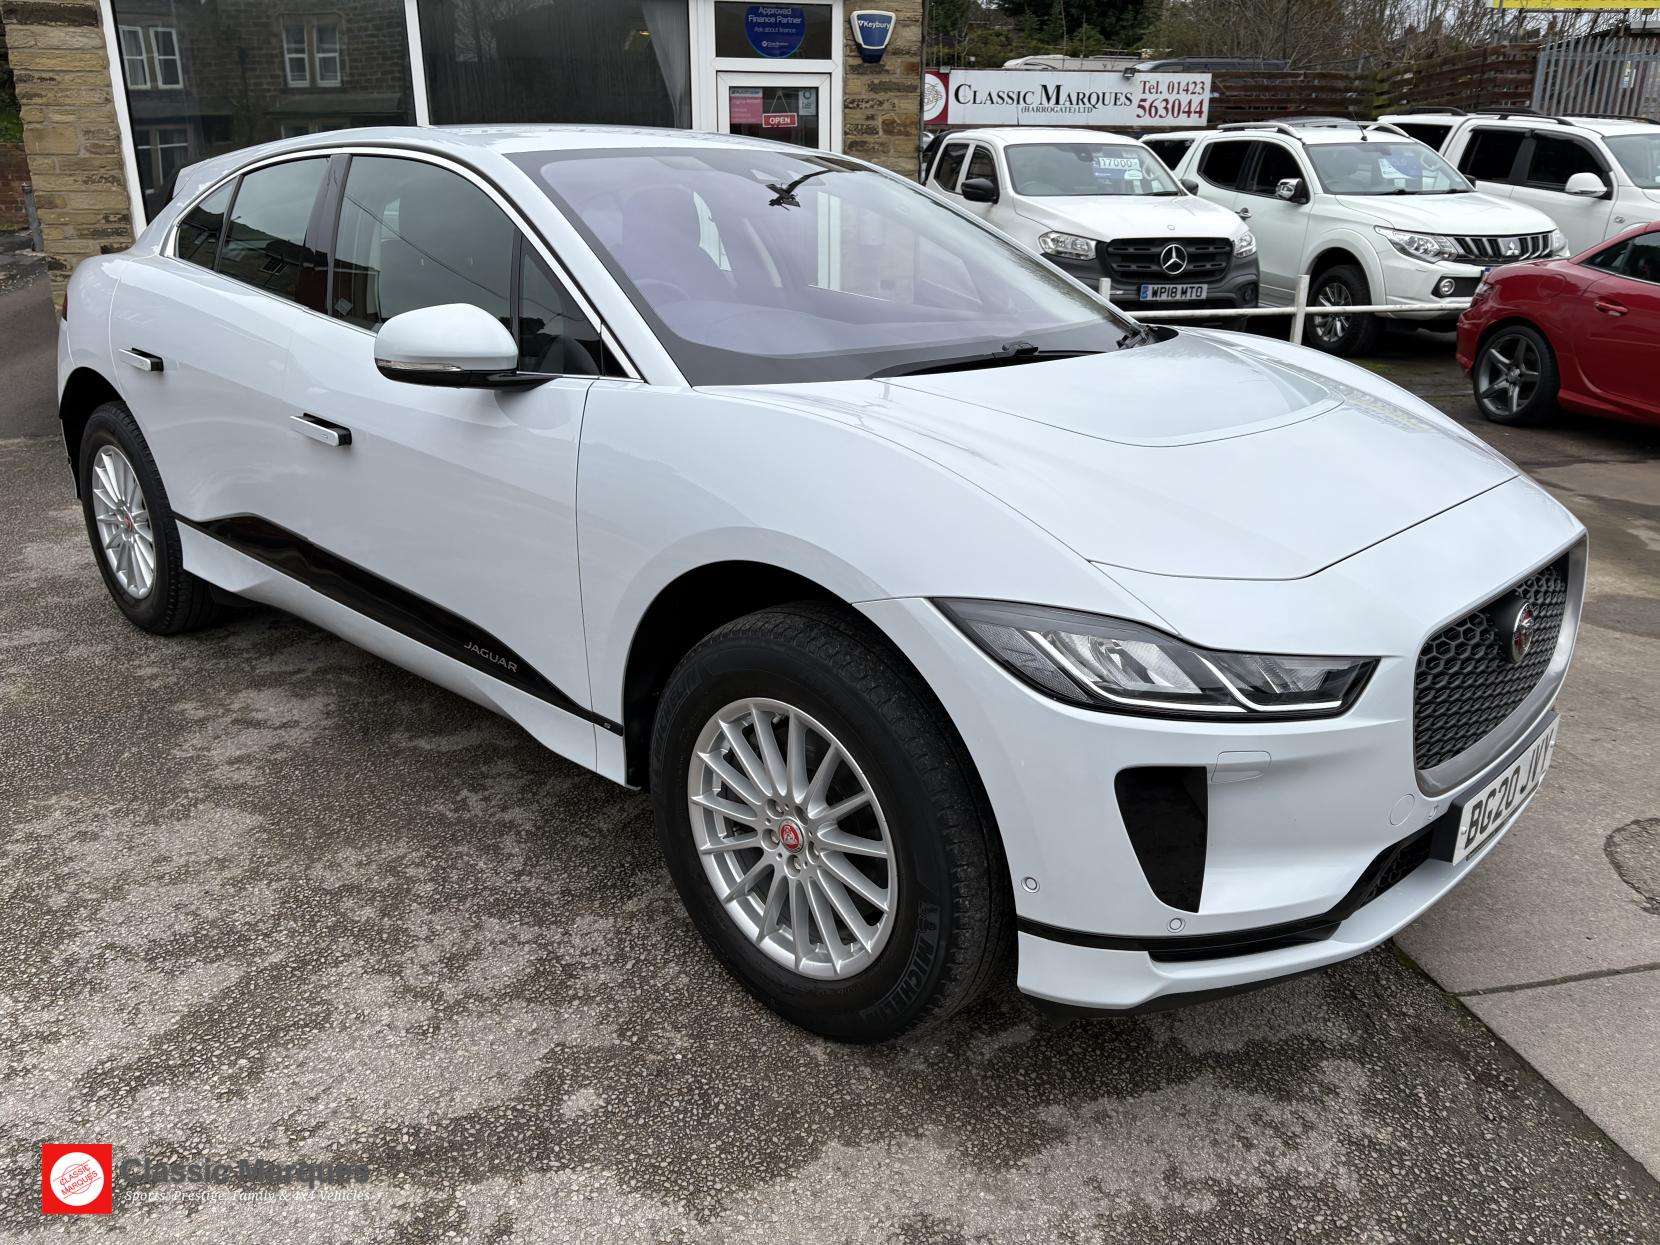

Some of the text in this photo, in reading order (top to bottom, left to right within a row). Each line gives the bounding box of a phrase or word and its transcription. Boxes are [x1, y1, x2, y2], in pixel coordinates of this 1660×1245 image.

[758, 6, 791, 15] Approved
[748, 14, 802, 23] Finance Partner
[863, 20, 890, 30] Keybury
[1140, 80, 1206, 95] Tel. 01423
[954, 83, 1035, 105] CLASSIC
[1039, 84, 1133, 109] MARQUES
[1021, 106, 1076, 114] (HARROGATE)
[1136, 98, 1204, 118] 563044
[1152, 286, 1203, 298] WP18 MTO
[463, 641, 518, 673] JAGUAR
[1465, 765, 1521, 850] BG20
